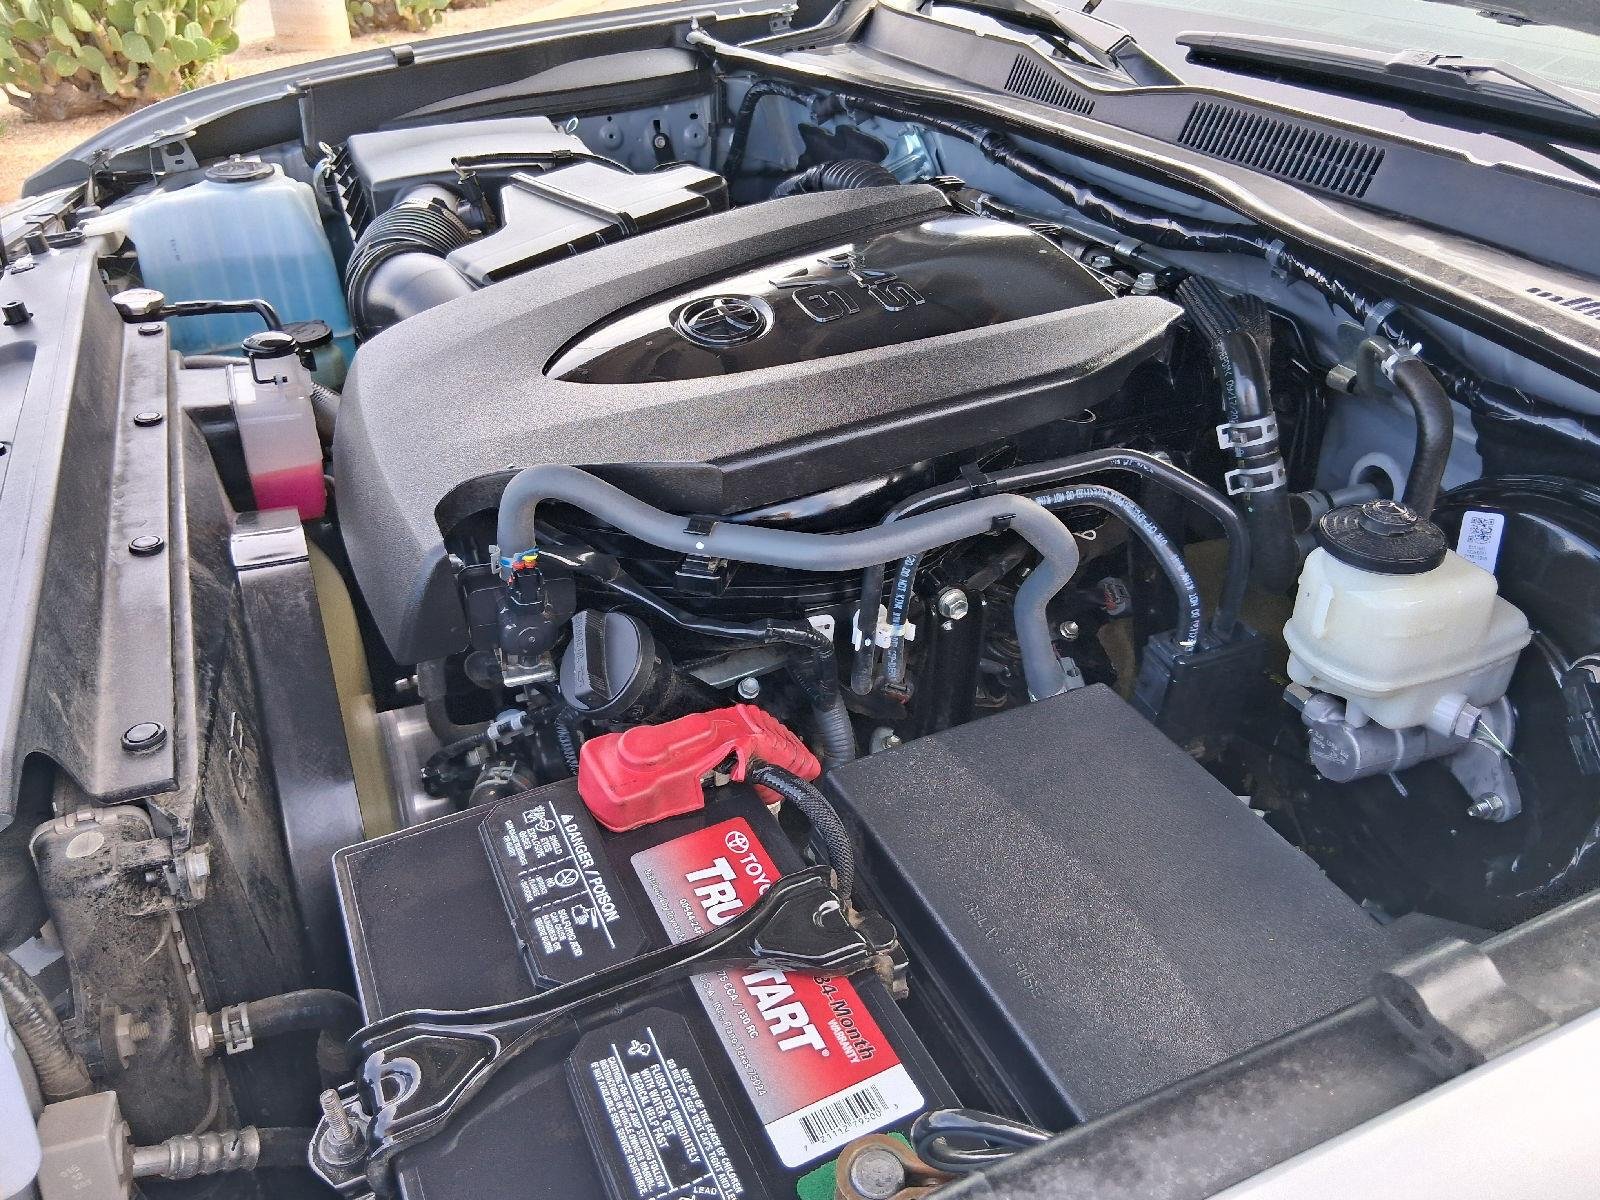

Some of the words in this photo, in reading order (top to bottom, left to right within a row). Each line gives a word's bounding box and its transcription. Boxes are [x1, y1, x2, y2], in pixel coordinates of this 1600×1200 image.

[564, 823, 594, 869] DANGER
[589, 876, 620, 922] POISON
[740, 853, 773, 896] TOYO
[558, 909, 576, 941] SULFURIC
[569, 941, 582, 956] ACID
[680, 898, 705, 935] 00544-24F
[723, 982, 738, 1001] CCA
[737, 1008, 751, 1025] 130
[746, 1025, 759, 1039] RC
[827, 1019, 861, 1063] WARRANTY
[666, 1058, 677, 1069] DO
[671, 1069, 683, 1082] NOT
[680, 1068, 693, 1084] KEEP
[735, 1045, 752, 1069] Texas
[747, 1069, 767, 1096] 75024
[598, 1059, 622, 1101] INSTRUCTIONS
[687, 1085, 700, 1098] OUT
[615, 1101, 624, 1109] IN
[630, 1072, 652, 1107] MEDICAL
[643, 1106, 660, 1126] HELP
[652, 1127, 669, 1147] FAST
[640, 1068, 655, 1090] WITH
[648, 1089, 668, 1120] WATER.
[661, 1120, 676, 1135] GET
[649, 1064, 668, 1089] FLUSH
[661, 1089, 676, 1109] EYES
[669, 1109, 701, 1163] IMMEDIATELY
[683, 1096, 696, 1113] KEEP
[694, 1099, 705, 1108] OF
[618, 1108, 635, 1135] VEHICLE
[691, 1113, 705, 1131] VENT
[699, 1109, 711, 1124] THE
[617, 1083, 629, 1097] FOR
[623, 1095, 635, 1112] SAFE
[636, 1128, 655, 1160] STARTING
[648, 1159, 666, 1187] FOLLOW
[699, 1132, 713, 1151] CAPS
[705, 1123, 721, 1146] REACH
[628, 1134, 645, 1161] OWNERS
[715, 1147, 727, 1156] OF
[616, 1127, 633, 1155] SERVICE
[626, 1153, 649, 1197] ASSISTANCE.
[708, 1150, 724, 1172] TIGHT
[717, 1173, 730, 1189] AND
[721, 1157, 743, 1193] CHILDREN
[693, 1186, 717, 1195] LEAD
